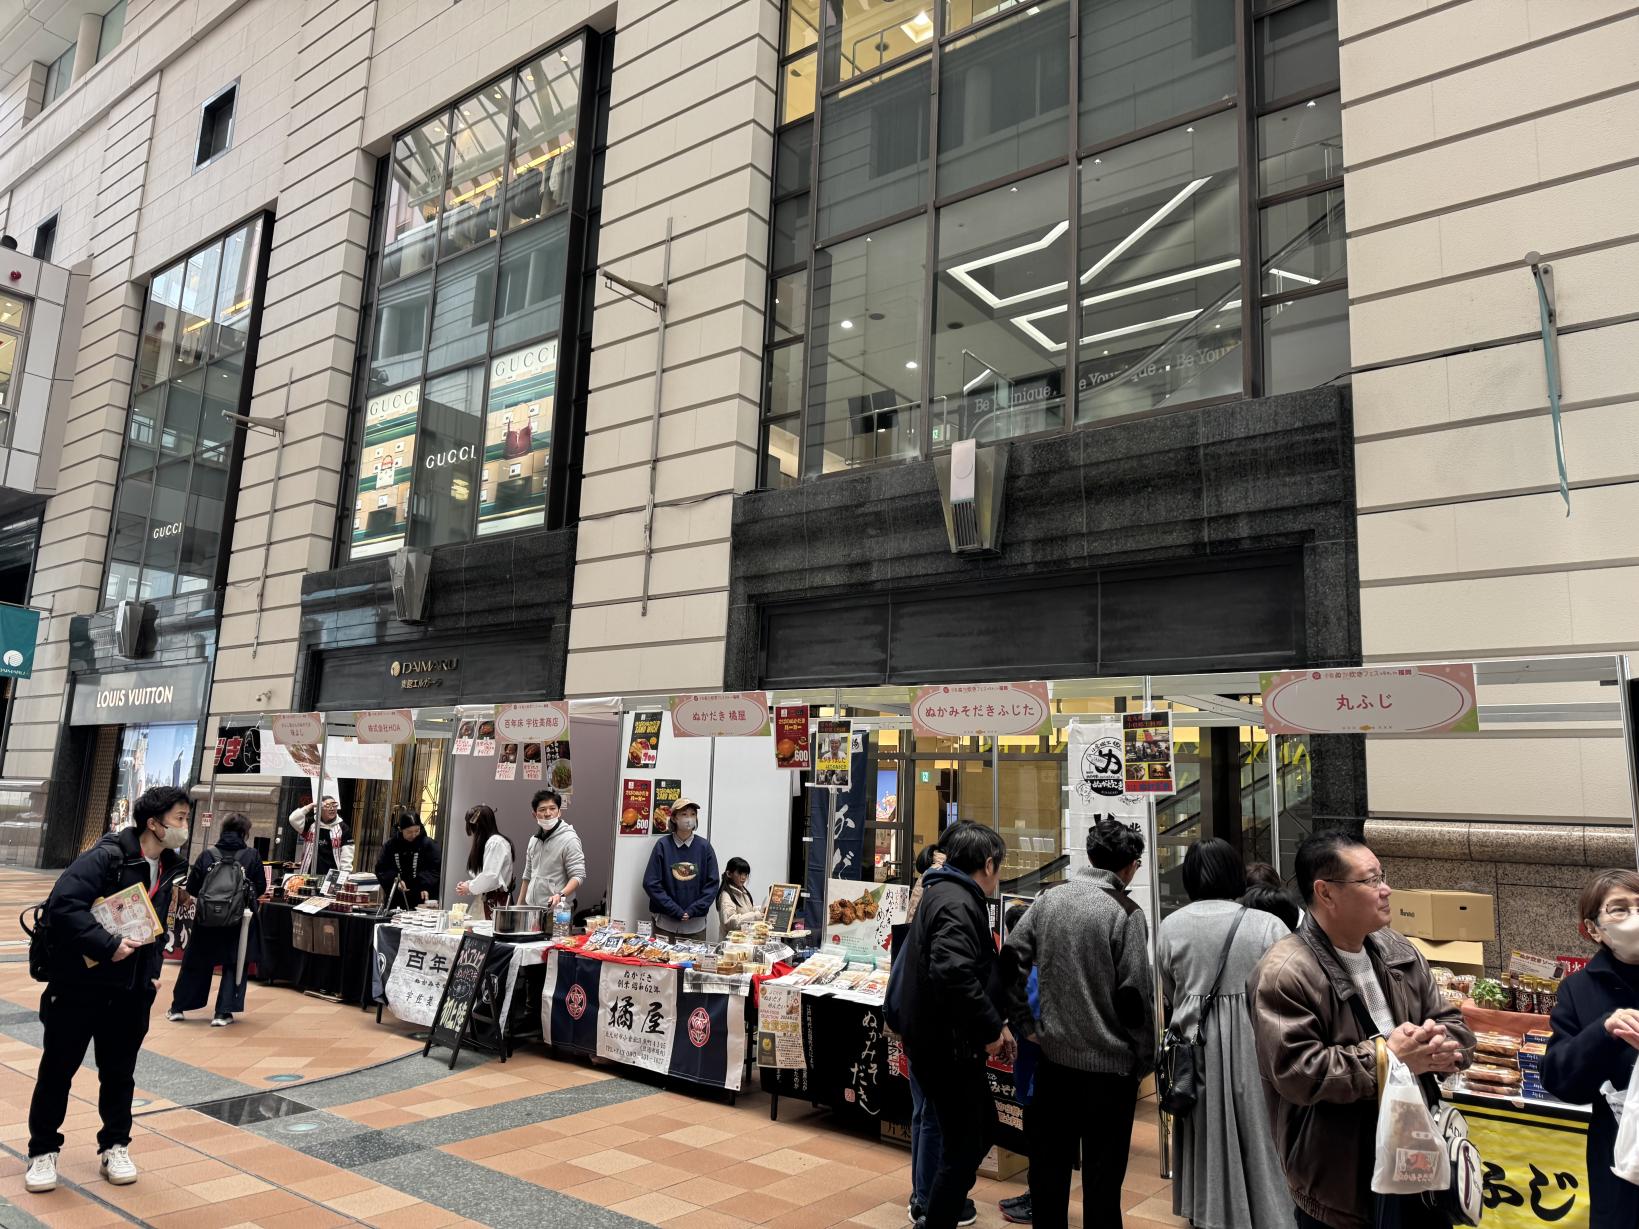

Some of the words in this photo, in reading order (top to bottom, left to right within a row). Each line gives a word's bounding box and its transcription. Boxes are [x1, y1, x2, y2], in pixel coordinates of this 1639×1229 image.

[495, 343, 558, 378] GUCCI
[369, 389, 420, 417] GUCCI
[974, 398, 990, 414] Be
[425, 444, 477, 470] GUCCI
[153, 521, 183, 539] GUCCI
[402, 657, 459, 674] DAIMARU
[96, 689, 125, 708] LOUIS
[128, 685, 173, 705] VUITTON
[1336, 693, 1393, 711] 丸ふじ
[692, 710, 726, 722] ぬかだき
[925, 703, 1035, 718] ぬかみそだきふじた
[794, 750, 809, 762] 600
[636, 819, 649, 830] 600
[406, 949, 449, 974] 百年
[414, 978, 447, 990] ぬかみそ
[623, 970, 653, 983] ぬかだき
[406, 990, 434, 1007] 宇佐美
[608, 995, 665, 1035] 橘屋
[860, 1010, 883, 1085] ぬかみそ
